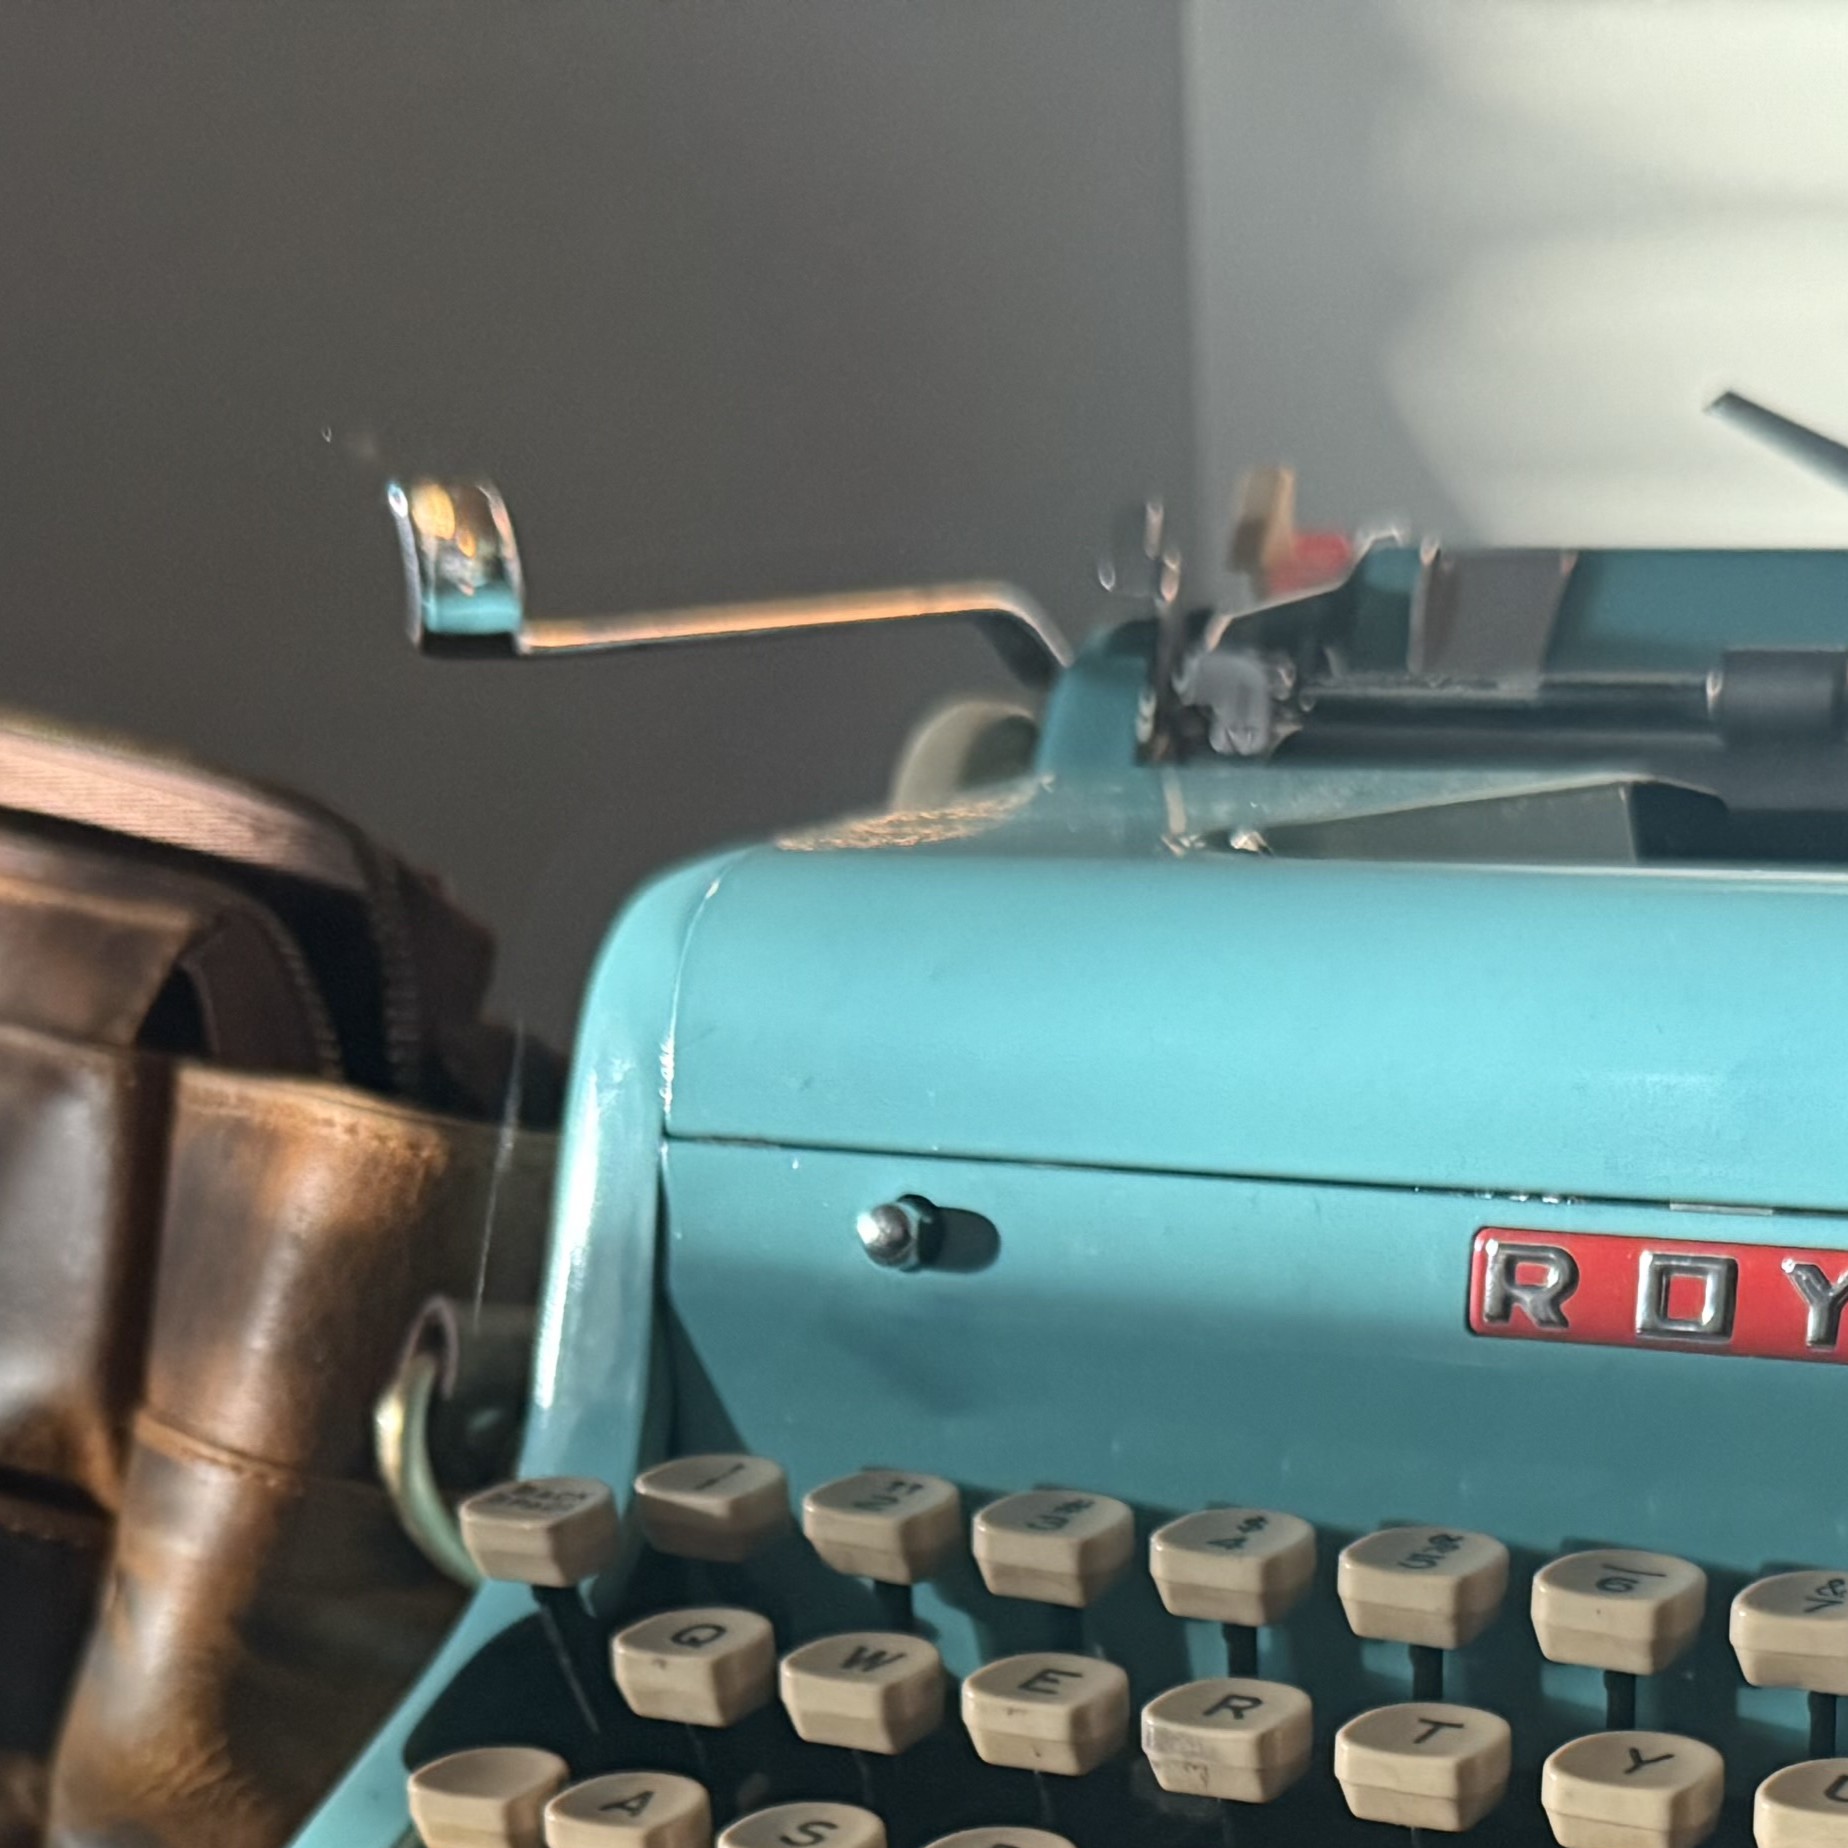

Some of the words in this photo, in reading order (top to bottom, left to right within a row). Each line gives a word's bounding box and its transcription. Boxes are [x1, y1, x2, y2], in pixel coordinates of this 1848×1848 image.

[1025, 1513, 1070, 1531] 3
[1206, 1536, 1249, 1551] 4
[1595, 1575, 1640, 1593] 6
[1804, 1595, 1845, 1614] 7
[671, 1622, 728, 1648] Q
[840, 1646, 907, 1672] W
[1017, 1668, 1084, 1695] E
[1202, 1693, 1263, 1720] R
[1413, 1717, 1465, 1744] T
[1624, 1746, 1675, 1775] Y
[600, 1790, 655, 1817] A
[779, 1821, 838, 1847] S
